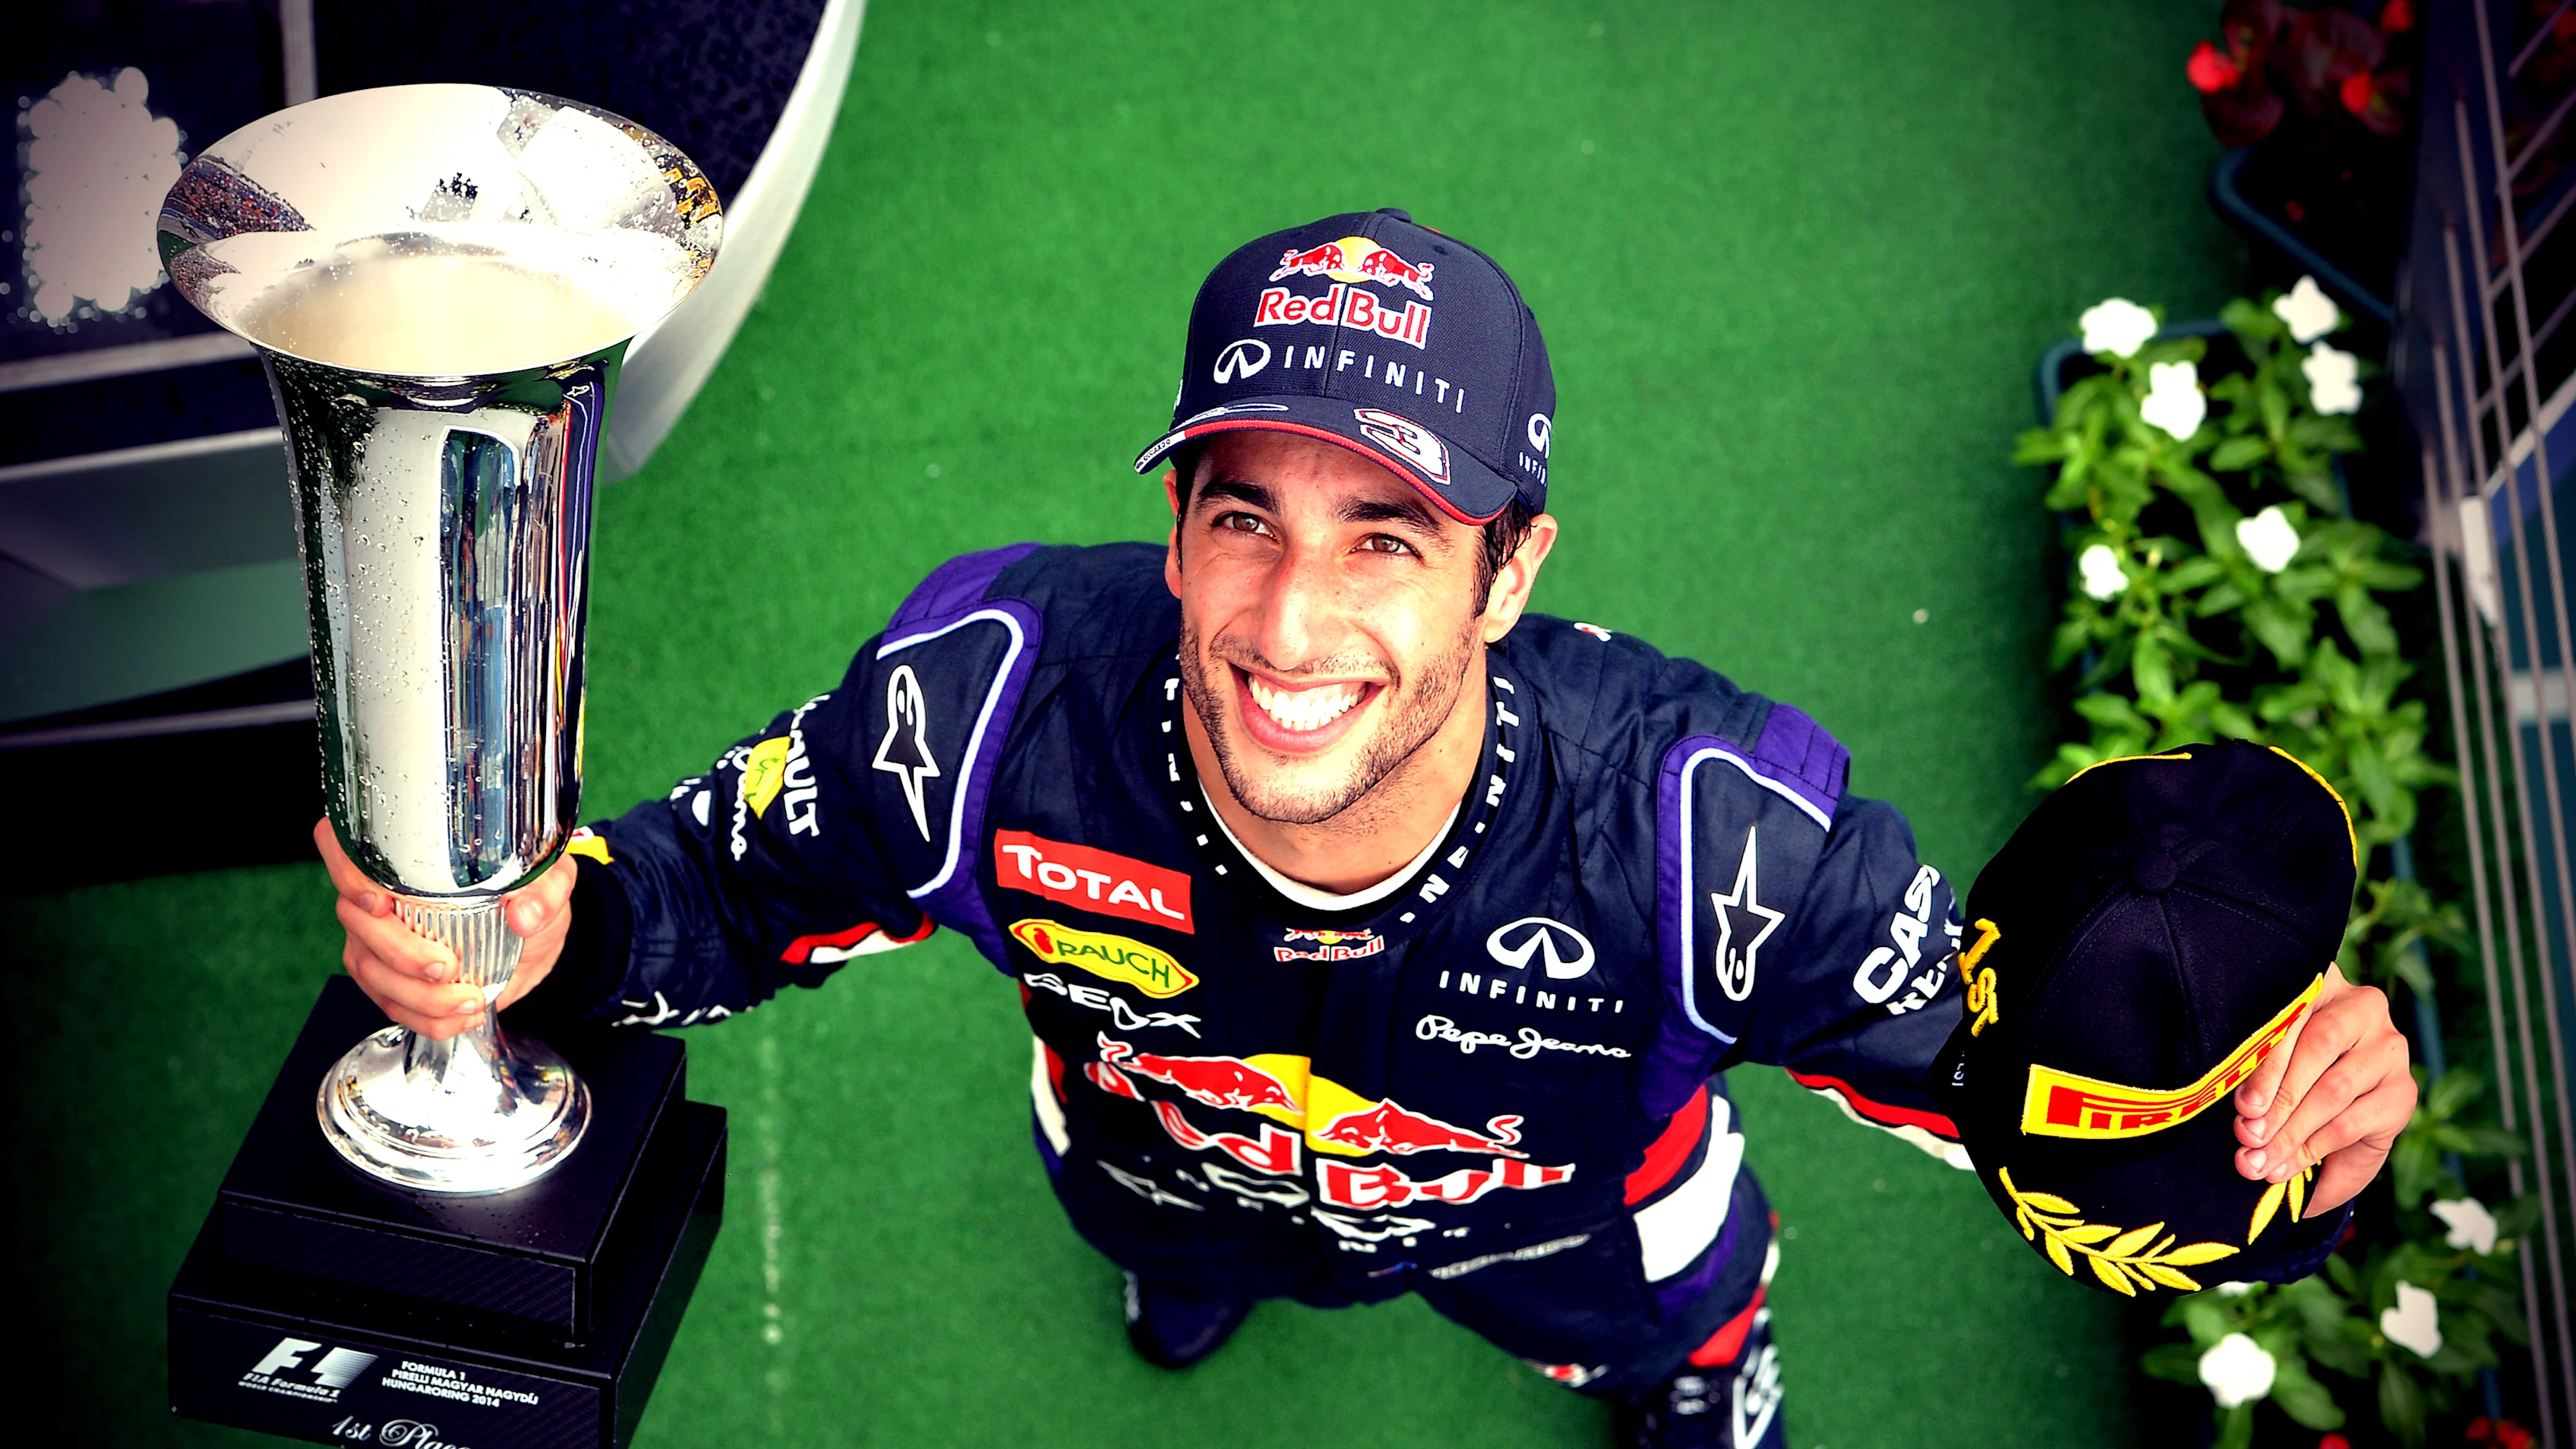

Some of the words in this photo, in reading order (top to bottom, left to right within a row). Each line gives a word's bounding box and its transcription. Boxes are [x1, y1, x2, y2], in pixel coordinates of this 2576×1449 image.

[1253, 283, 1346, 327] Red
[1340, 287, 1432, 349] Bull
[1283, 345, 1465, 414] INFINITI
[1353, 408, 1451, 486] 3
[1519, 451, 1547, 486] INFIN
[1002, 844, 1185, 920] TOTAL
[1274, 945, 1330, 961] Red
[1331, 935, 1384, 961] Bull
[1853, 864, 1941, 1003] CAS
[1056, 939, 1170, 988] RAUCH
[1438, 970, 1624, 1013] INFINITI
[1416, 1014, 1512, 1054] Pepe
[1509, 1027, 1632, 1059] Jeans
[242, 1372, 270, 1384] FIA
[270, 1378, 330, 1396] Formula
[329, 1389, 341, 1398] 1
[381, 1377, 470, 1402] HUNGARORING
[472, 1394, 500, 1407] 2014
[391, 1368, 430, 1384] PIRELLI
[430, 1377, 485, 1395] MAGYAR
[401, 1360, 457, 1380] FORMULA
[459, 1372, 466, 1381] 1
[331, 1415, 372, 1441] 1st
[379, 1419, 472, 1449] Pla
